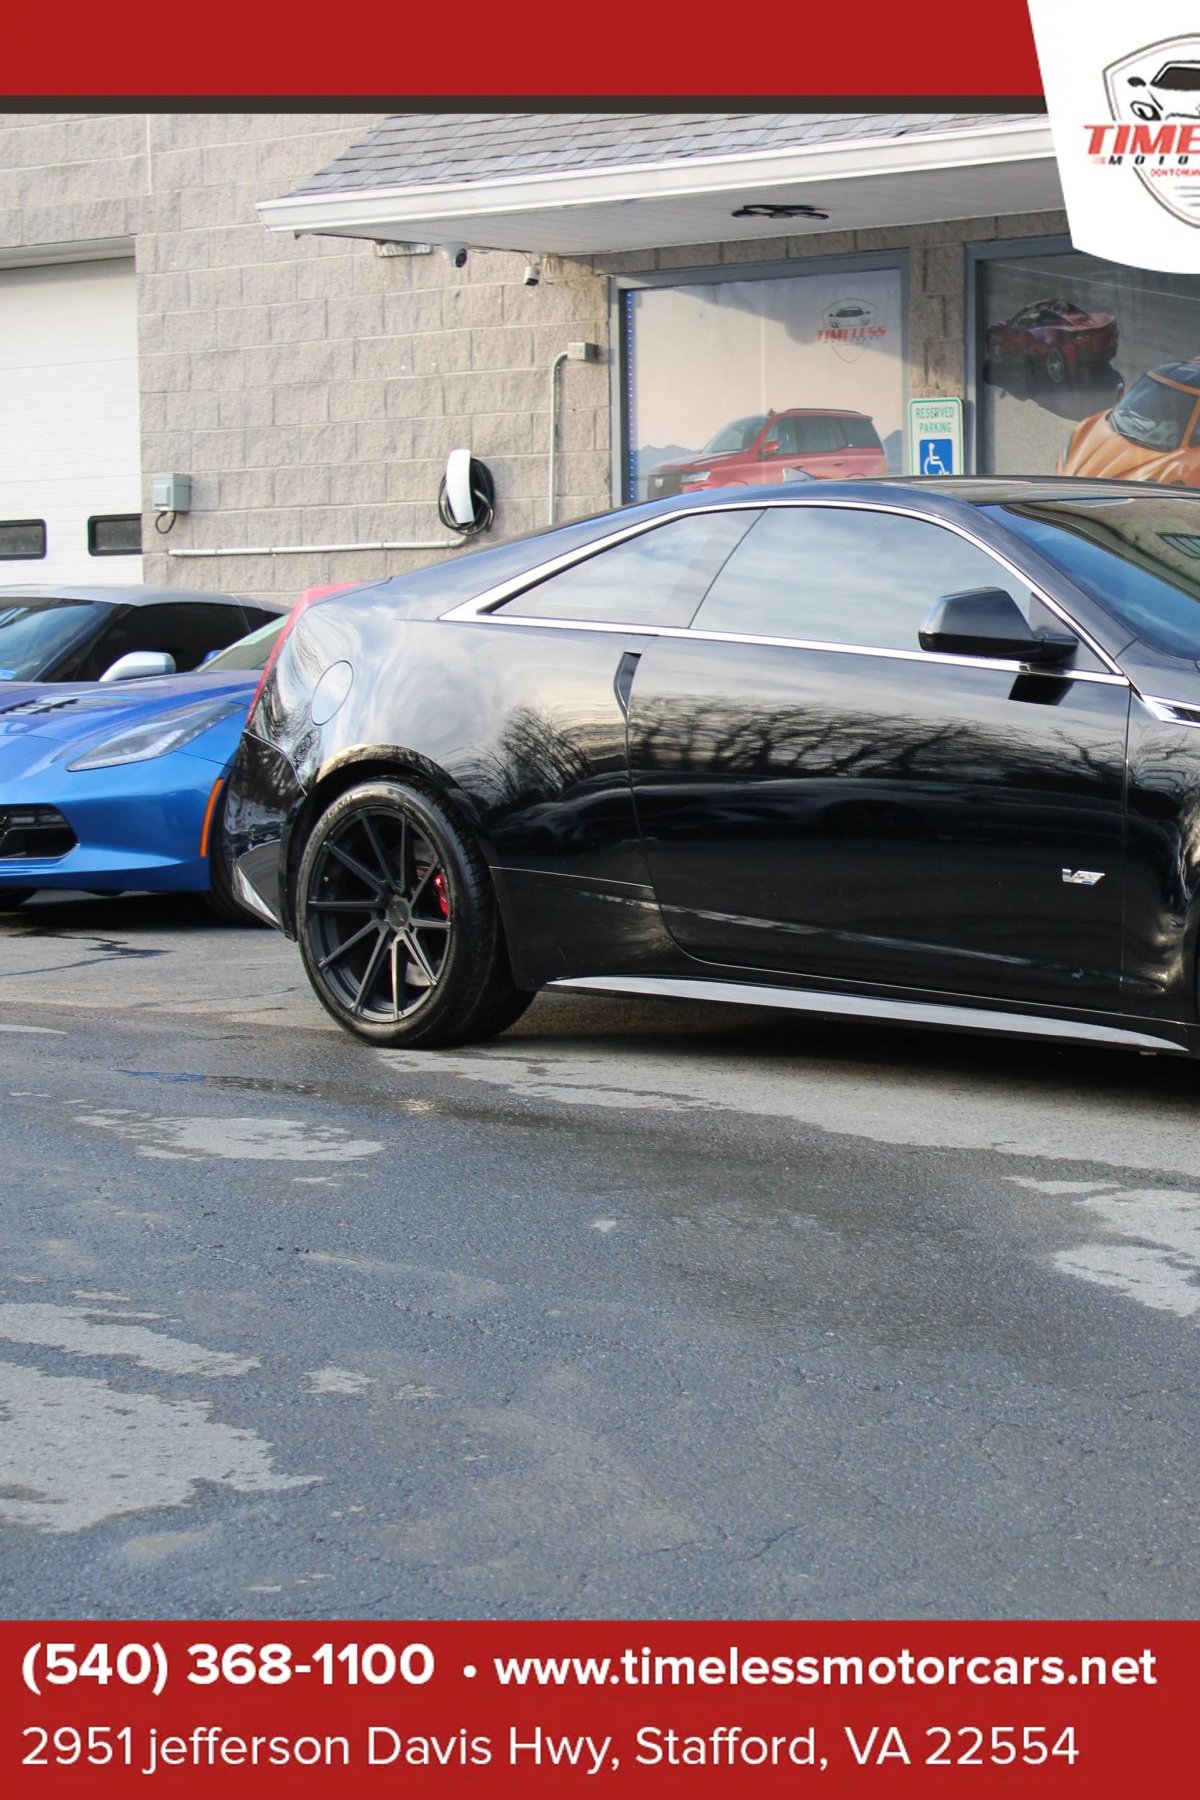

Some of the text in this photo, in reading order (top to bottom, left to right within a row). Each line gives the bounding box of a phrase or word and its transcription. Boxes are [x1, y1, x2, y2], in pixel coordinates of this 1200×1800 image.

[816, 326, 887, 340] TIMELESS
[915, 406, 954, 418] RESERVED
[919, 421, 952, 433] PARKING
